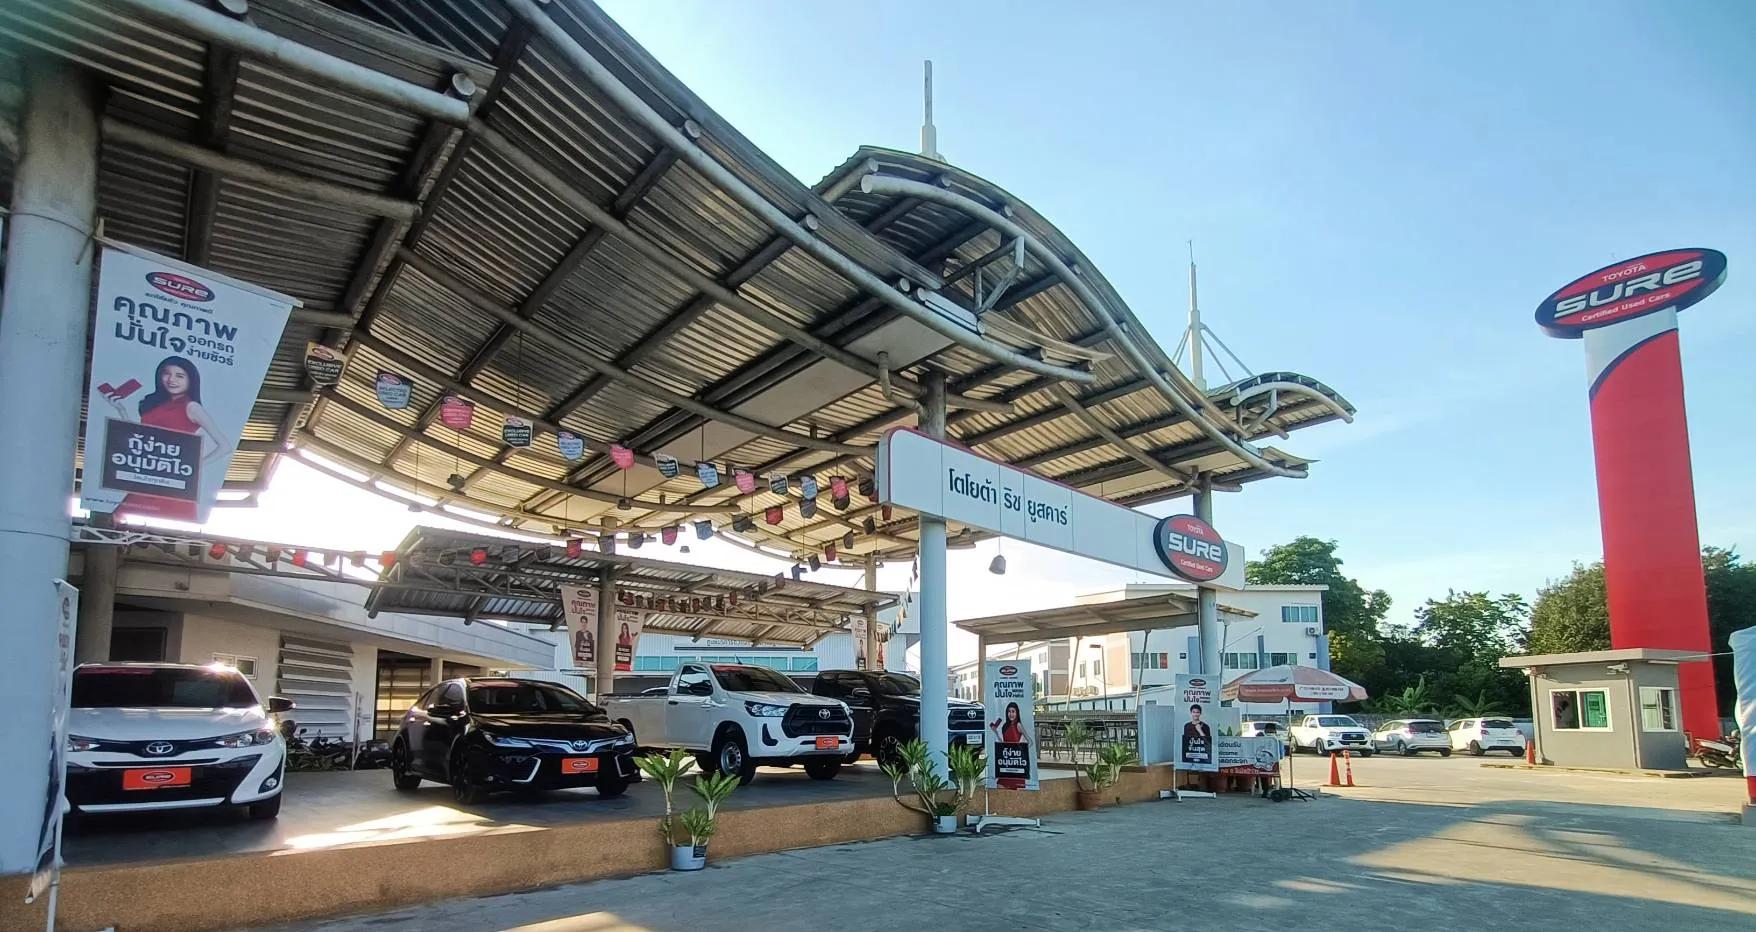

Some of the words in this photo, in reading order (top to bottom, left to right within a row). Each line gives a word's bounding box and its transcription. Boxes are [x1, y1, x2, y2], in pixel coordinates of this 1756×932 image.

[1602, 264, 1647, 282] TOYOTA
[153, 276, 209, 299] SURE
[1554, 260, 1703, 318] SURE
[1581, 306, 1619, 321] Certified
[1621, 298, 1645, 310] Used
[1648, 292, 1671, 302] Cars
[114, 296, 238, 341] คุณภาพ
[115, 319, 186, 353] มั่นใจ
[187, 334, 235, 353] ออกรถ
[186, 345, 234, 367] ง่ายชัวร์
[128, 433, 181, 456] กู้ง่าย
[111, 453, 193, 476] อนุมัติไว
[949, 468, 997, 505] โตโยต้า
[1003, 487, 1021, 512] ริช
[1027, 499, 1068, 526] ยูสคาร์
[1168, 532, 1222, 562] SURE
[994, 681, 1024, 691] คุณภาพ
